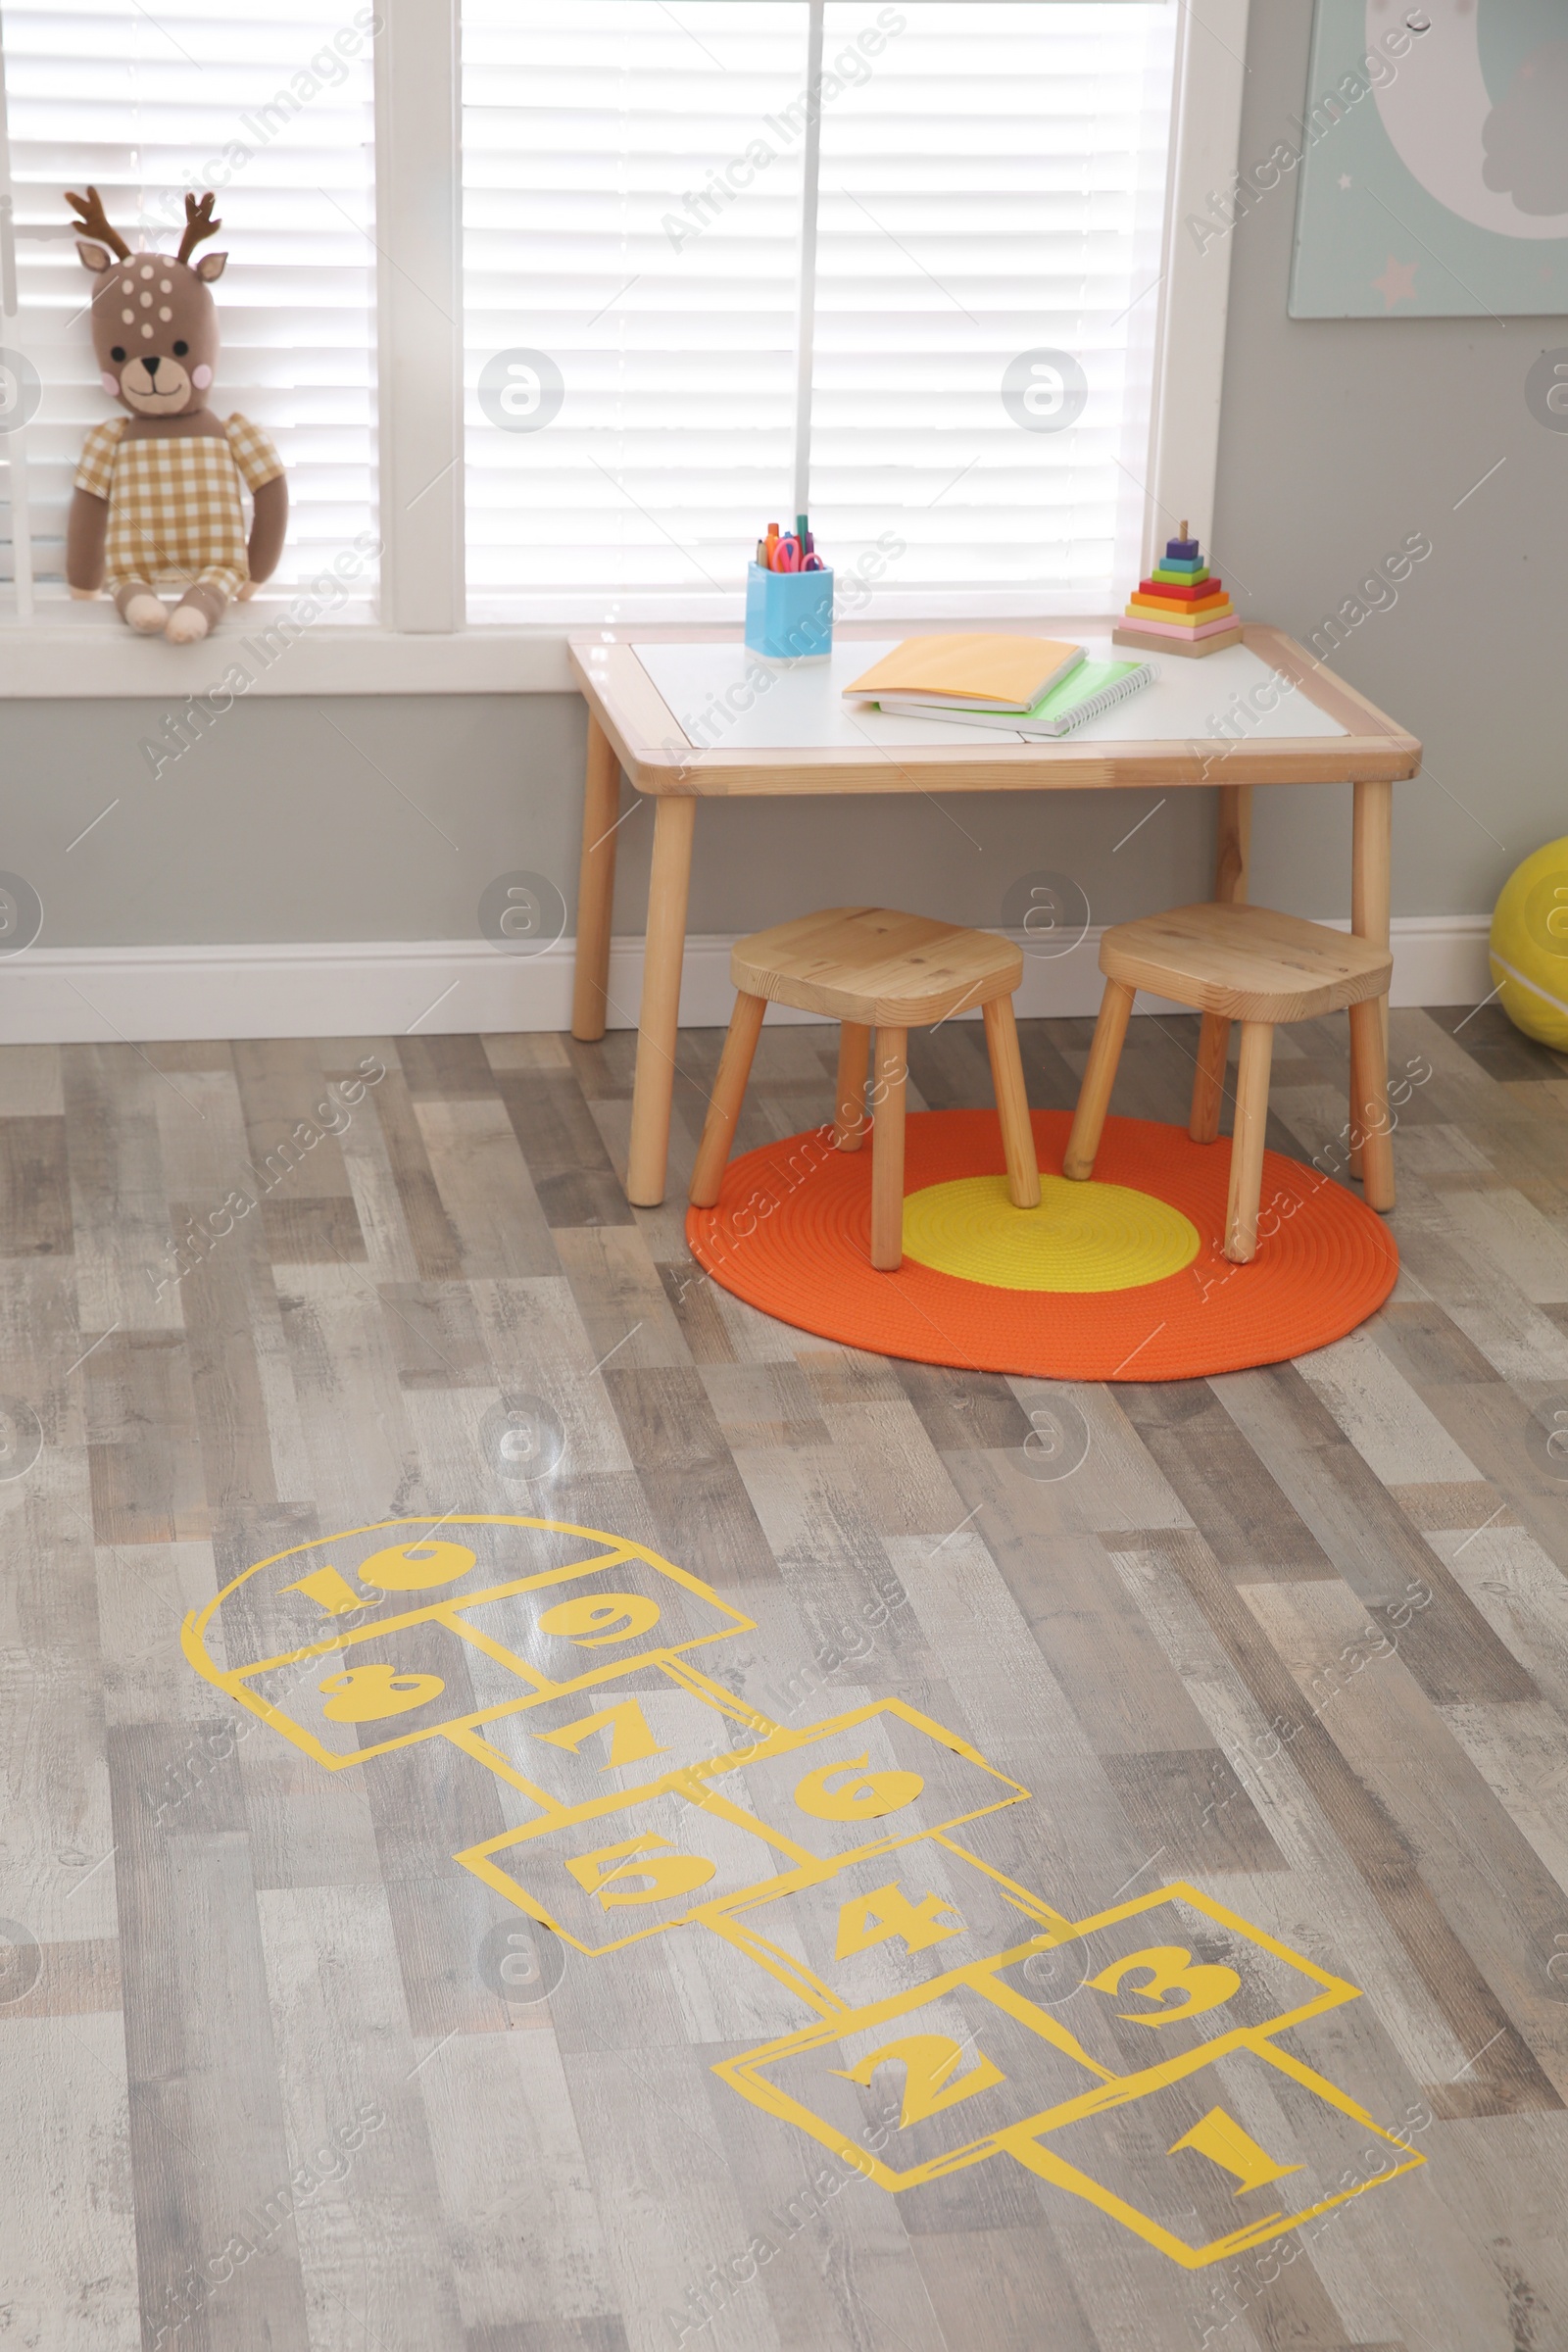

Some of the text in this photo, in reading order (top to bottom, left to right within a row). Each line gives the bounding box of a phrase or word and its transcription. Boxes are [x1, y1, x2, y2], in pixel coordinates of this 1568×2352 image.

[273, 1542, 475, 1620] 10
[539, 1593, 661, 1649] 9
[318, 1664, 445, 1723] 8
[530, 1697, 674, 1771] 7
[794, 1749, 924, 1821] 6
[564, 1831, 716, 1911] 5
[835, 1880, 968, 1961] 4
[1078, 1945, 1241, 2030] 3
[827, 2034, 1005, 2131] 2
[1165, 2105, 1307, 2197] 1
